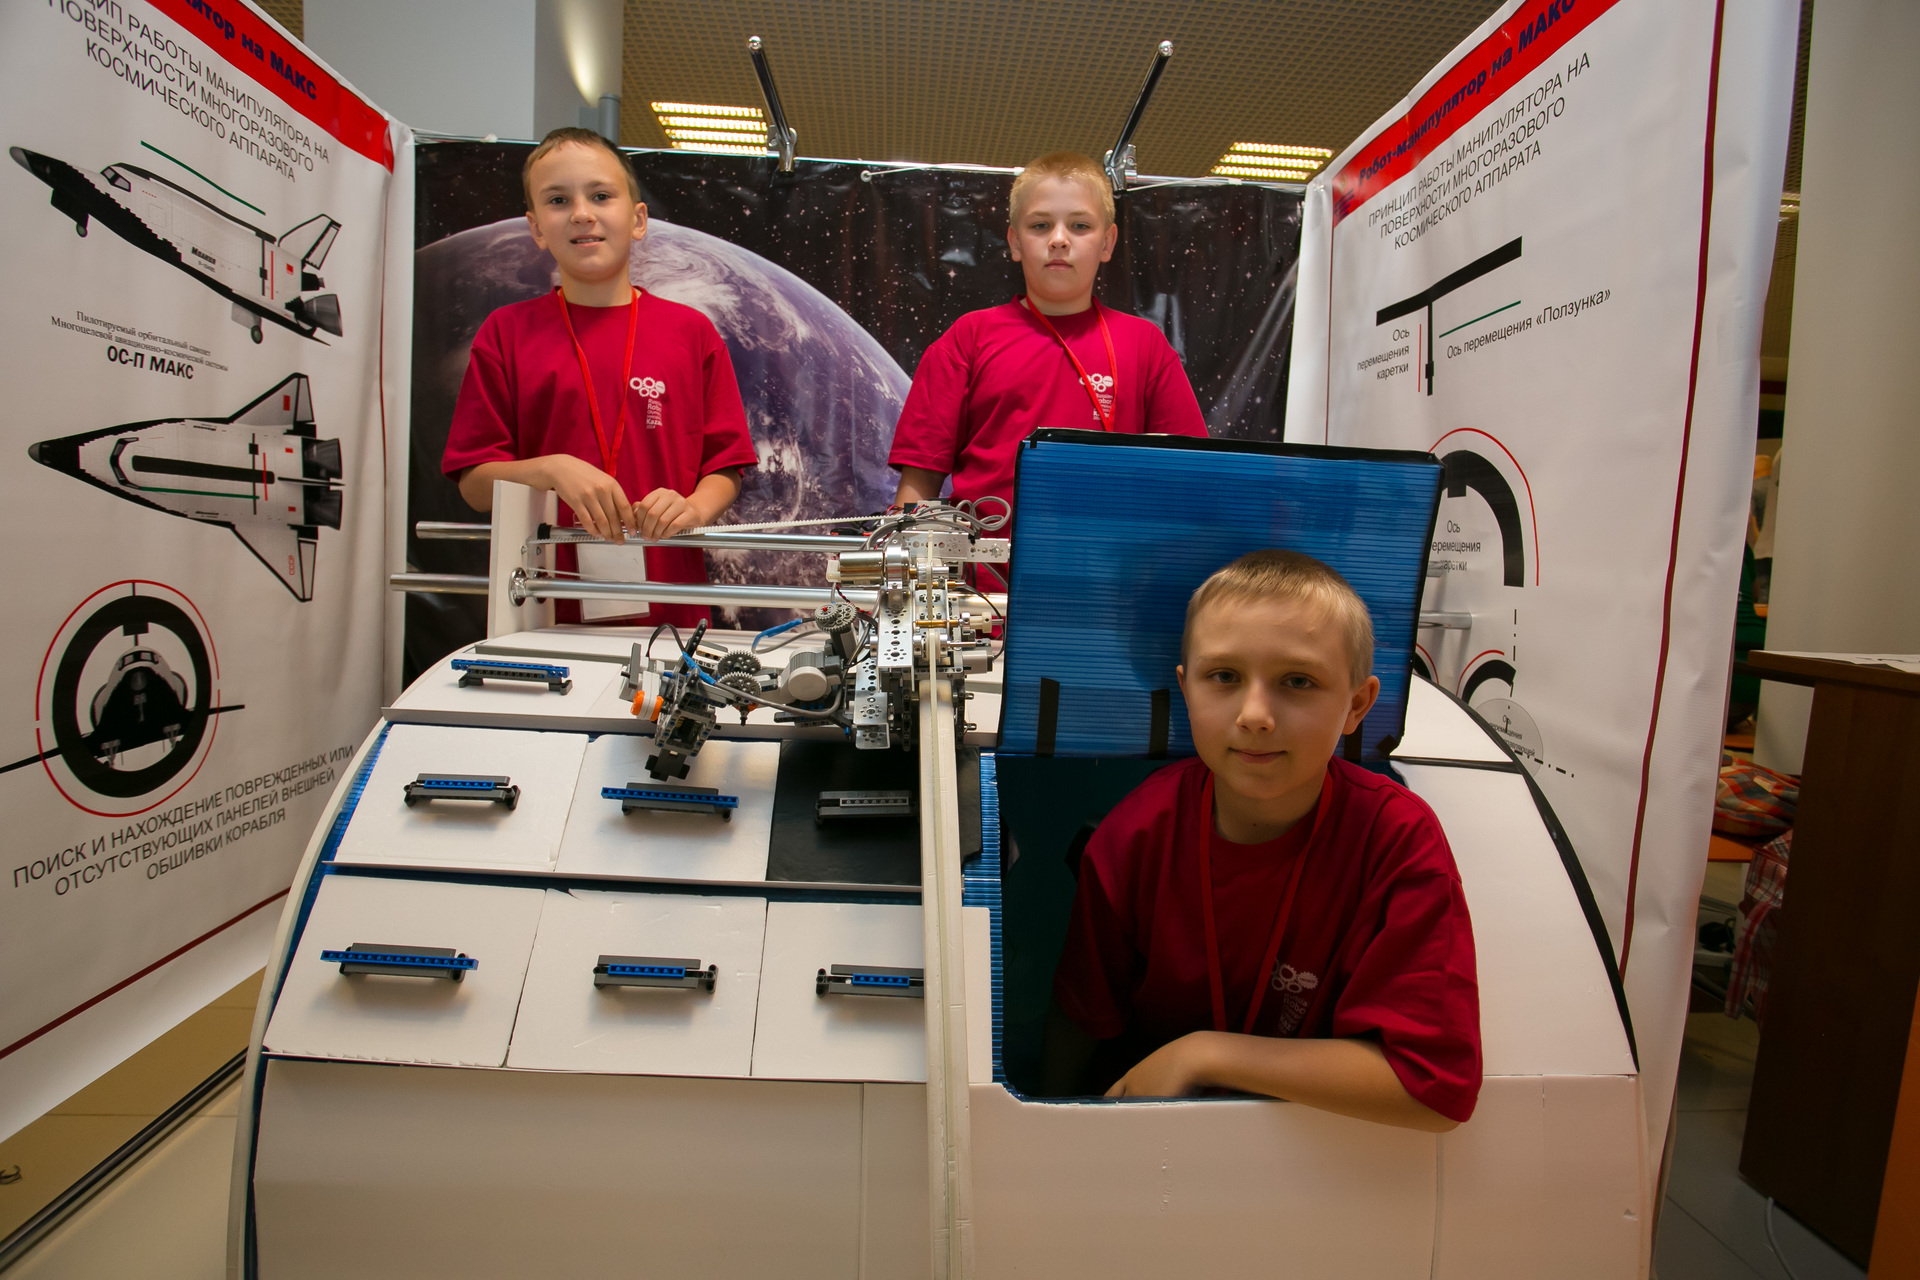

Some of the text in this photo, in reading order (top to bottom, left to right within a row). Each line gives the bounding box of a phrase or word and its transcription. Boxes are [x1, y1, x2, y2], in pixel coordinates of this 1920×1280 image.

[128, 14, 202, 77] РАБОТЫ
[205, 66, 311, 151] МАНИПУЛЯТОРА
[314, 142, 330, 163] НА
[241, 32, 317, 100] на МАКС
[86, 37, 296, 183] КОСМИЧЕСКОГО АППАРАТА
[201, 86, 314, 172] МНОГОРАЗОВОГО
[1358, 69, 1487, 186] Робот-манипулятор
[1490, 47, 1513, 78] на
[1368, 52, 1591, 228] ПРИНЦИП РАБОТЫ МАНИПУЛЯТОРА НА
[1380, 97, 1566, 239] ПОВЕРХНОСТИ МНОГОРАЗОВОГО
[1394, 140, 1542, 250] КОСМИЧЕСКОГО АППАРАТА
[51, 316, 113, 341] Многоцелевой
[76, 311, 136, 336] Пилотируемый
[1357, 344, 1410, 372] перемещения
[1392, 327, 1411, 342] Ось
[1446, 288, 1612, 360] Ось перемещения «Ползунка»
[107, 345, 194, 380] ОС-П МАКС
[1376, 363, 1409, 381] каретки
[1432, 541, 1481, 554] еремещения
[1446, 520, 1461, 533] Ось
[13, 745, 355, 889] ПОИСК И НАХОЖДЕНИЕ ПОВРЕЖДЕННЫХ ИЛИ
[55, 767, 335, 896] ОТСУТСТВУЮЩИХ ПАНЕЛЕЙ ВНЕШНЕЙ
[146, 808, 286, 881] ОБШИВКИ КОРАБЛЯ
